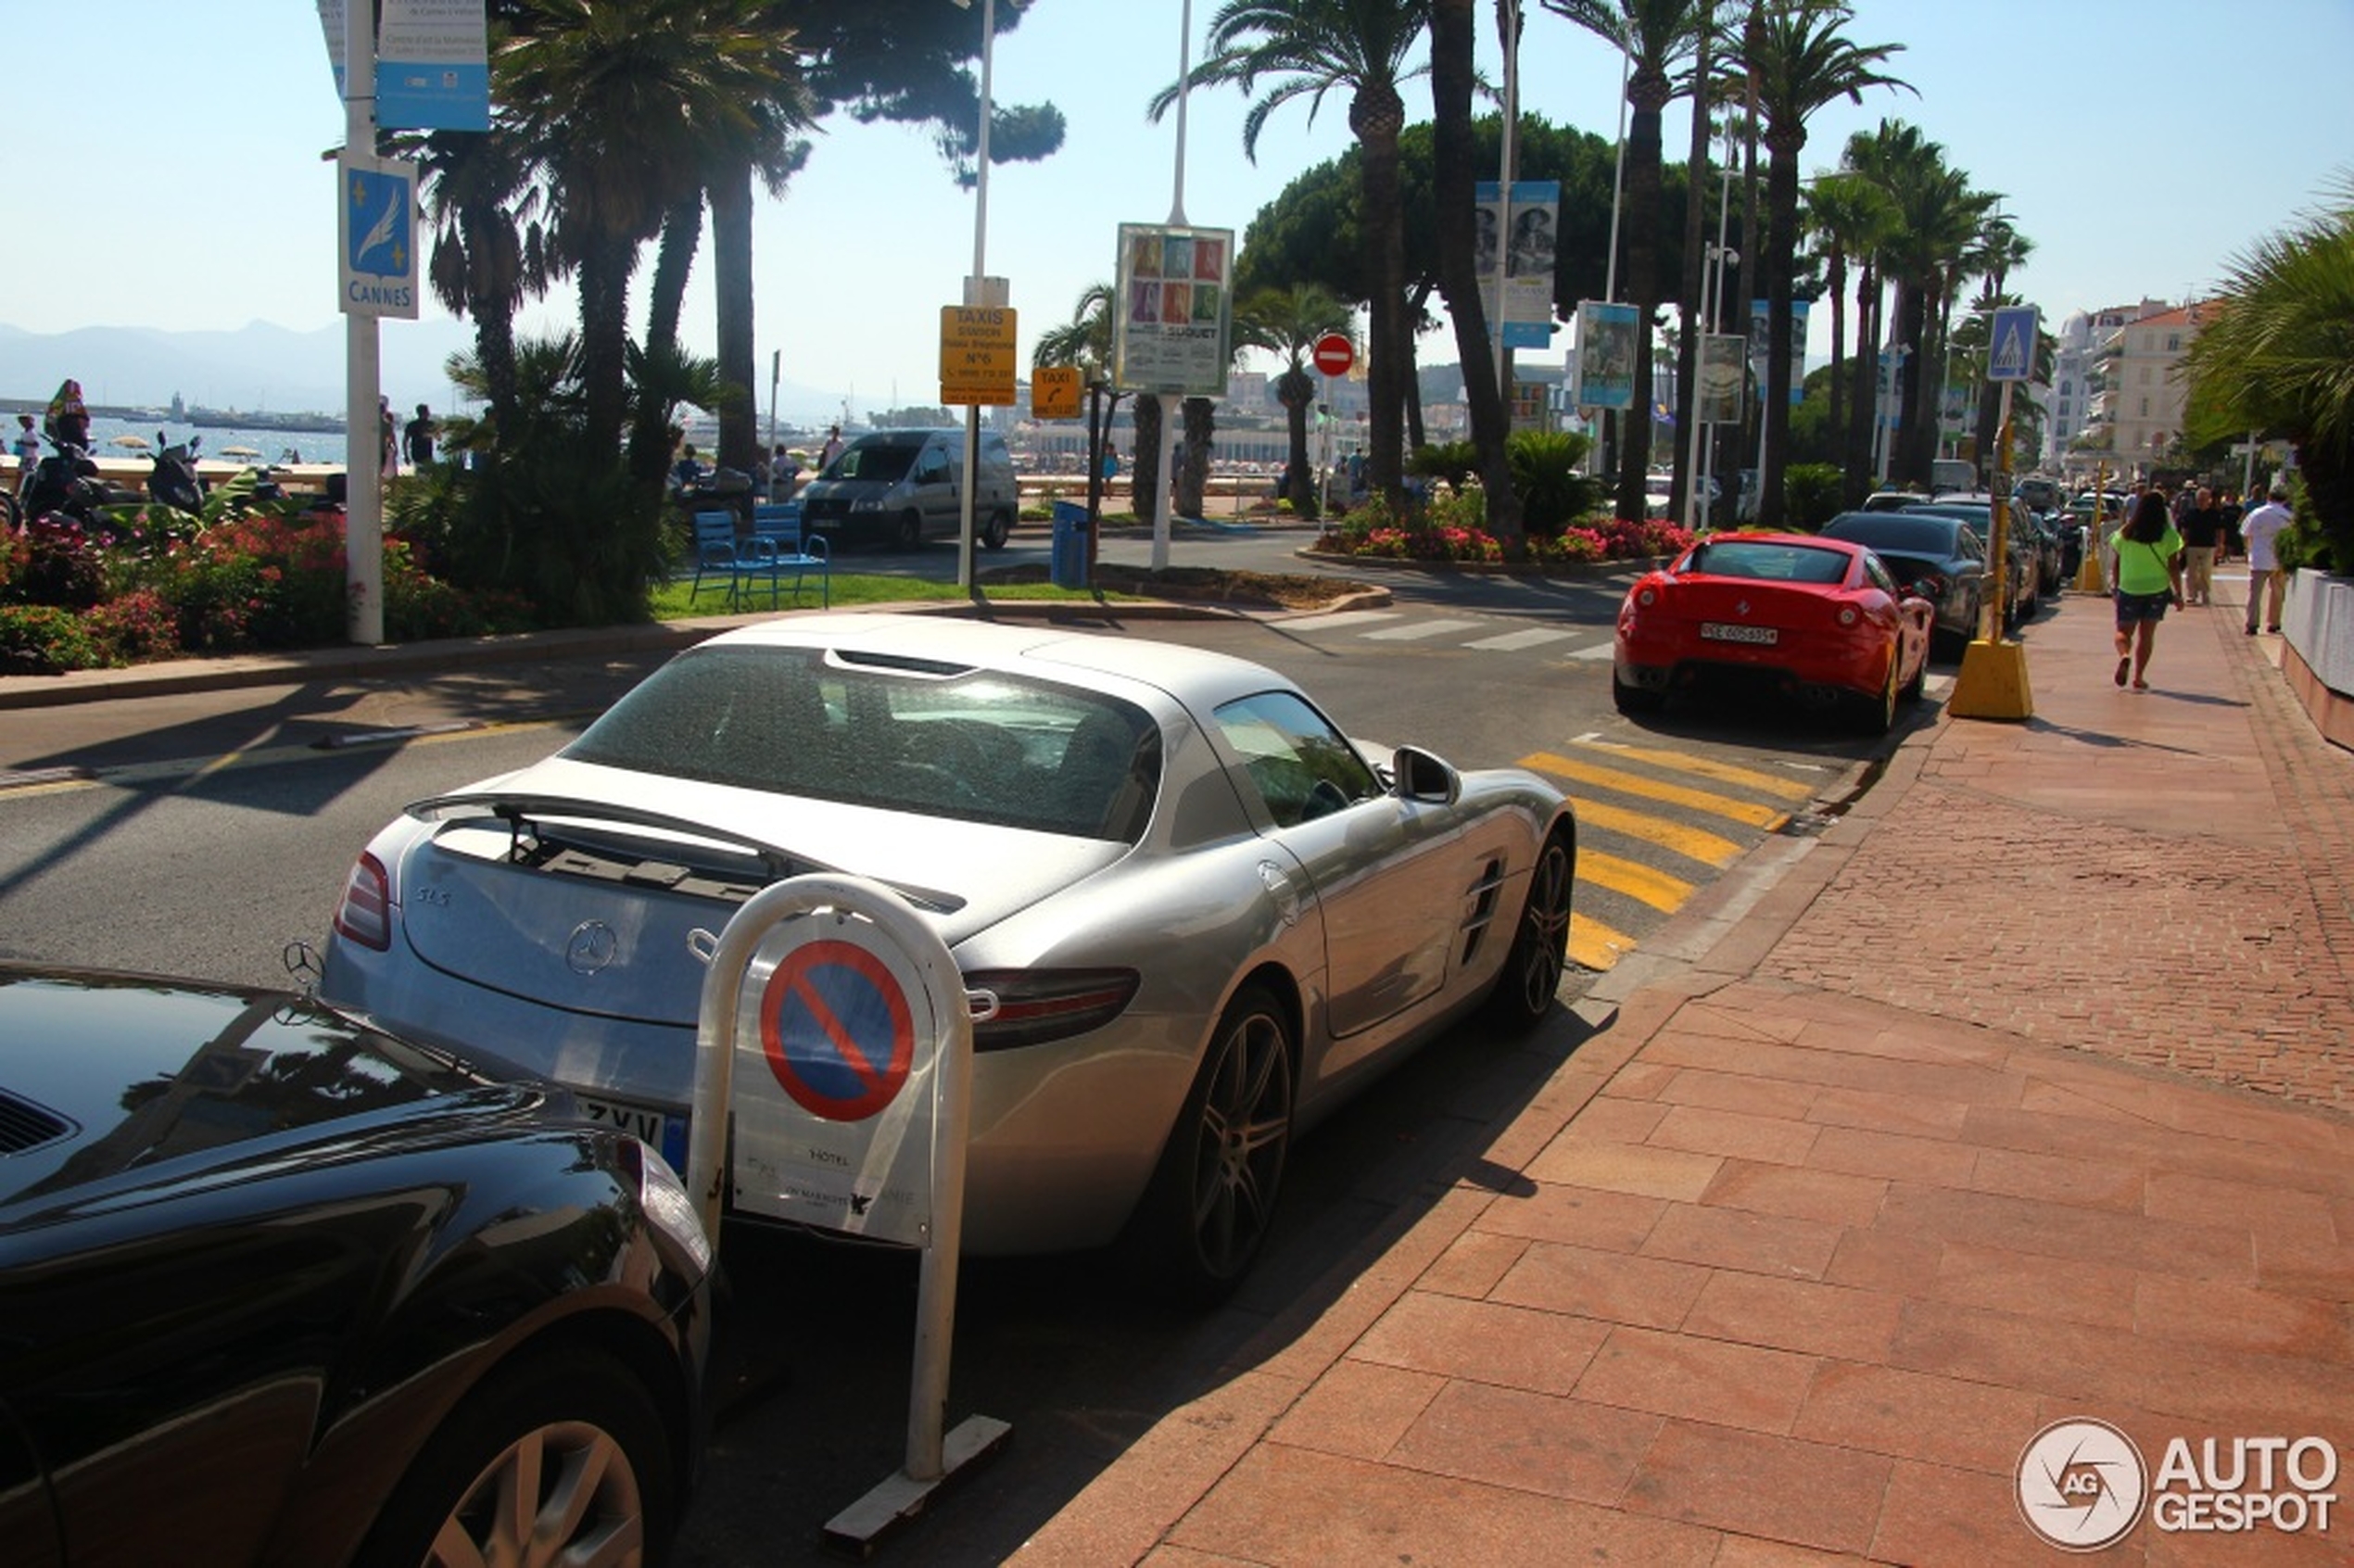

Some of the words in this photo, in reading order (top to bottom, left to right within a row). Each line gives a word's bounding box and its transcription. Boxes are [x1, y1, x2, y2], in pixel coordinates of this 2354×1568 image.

[348, 280, 411, 307] CANNES
[956, 310, 1004, 325] TAXIS
[1041, 372, 1070, 384] TAXI
[418, 888, 450, 906] SLS
[809, 1148, 850, 1167] HOTEL
